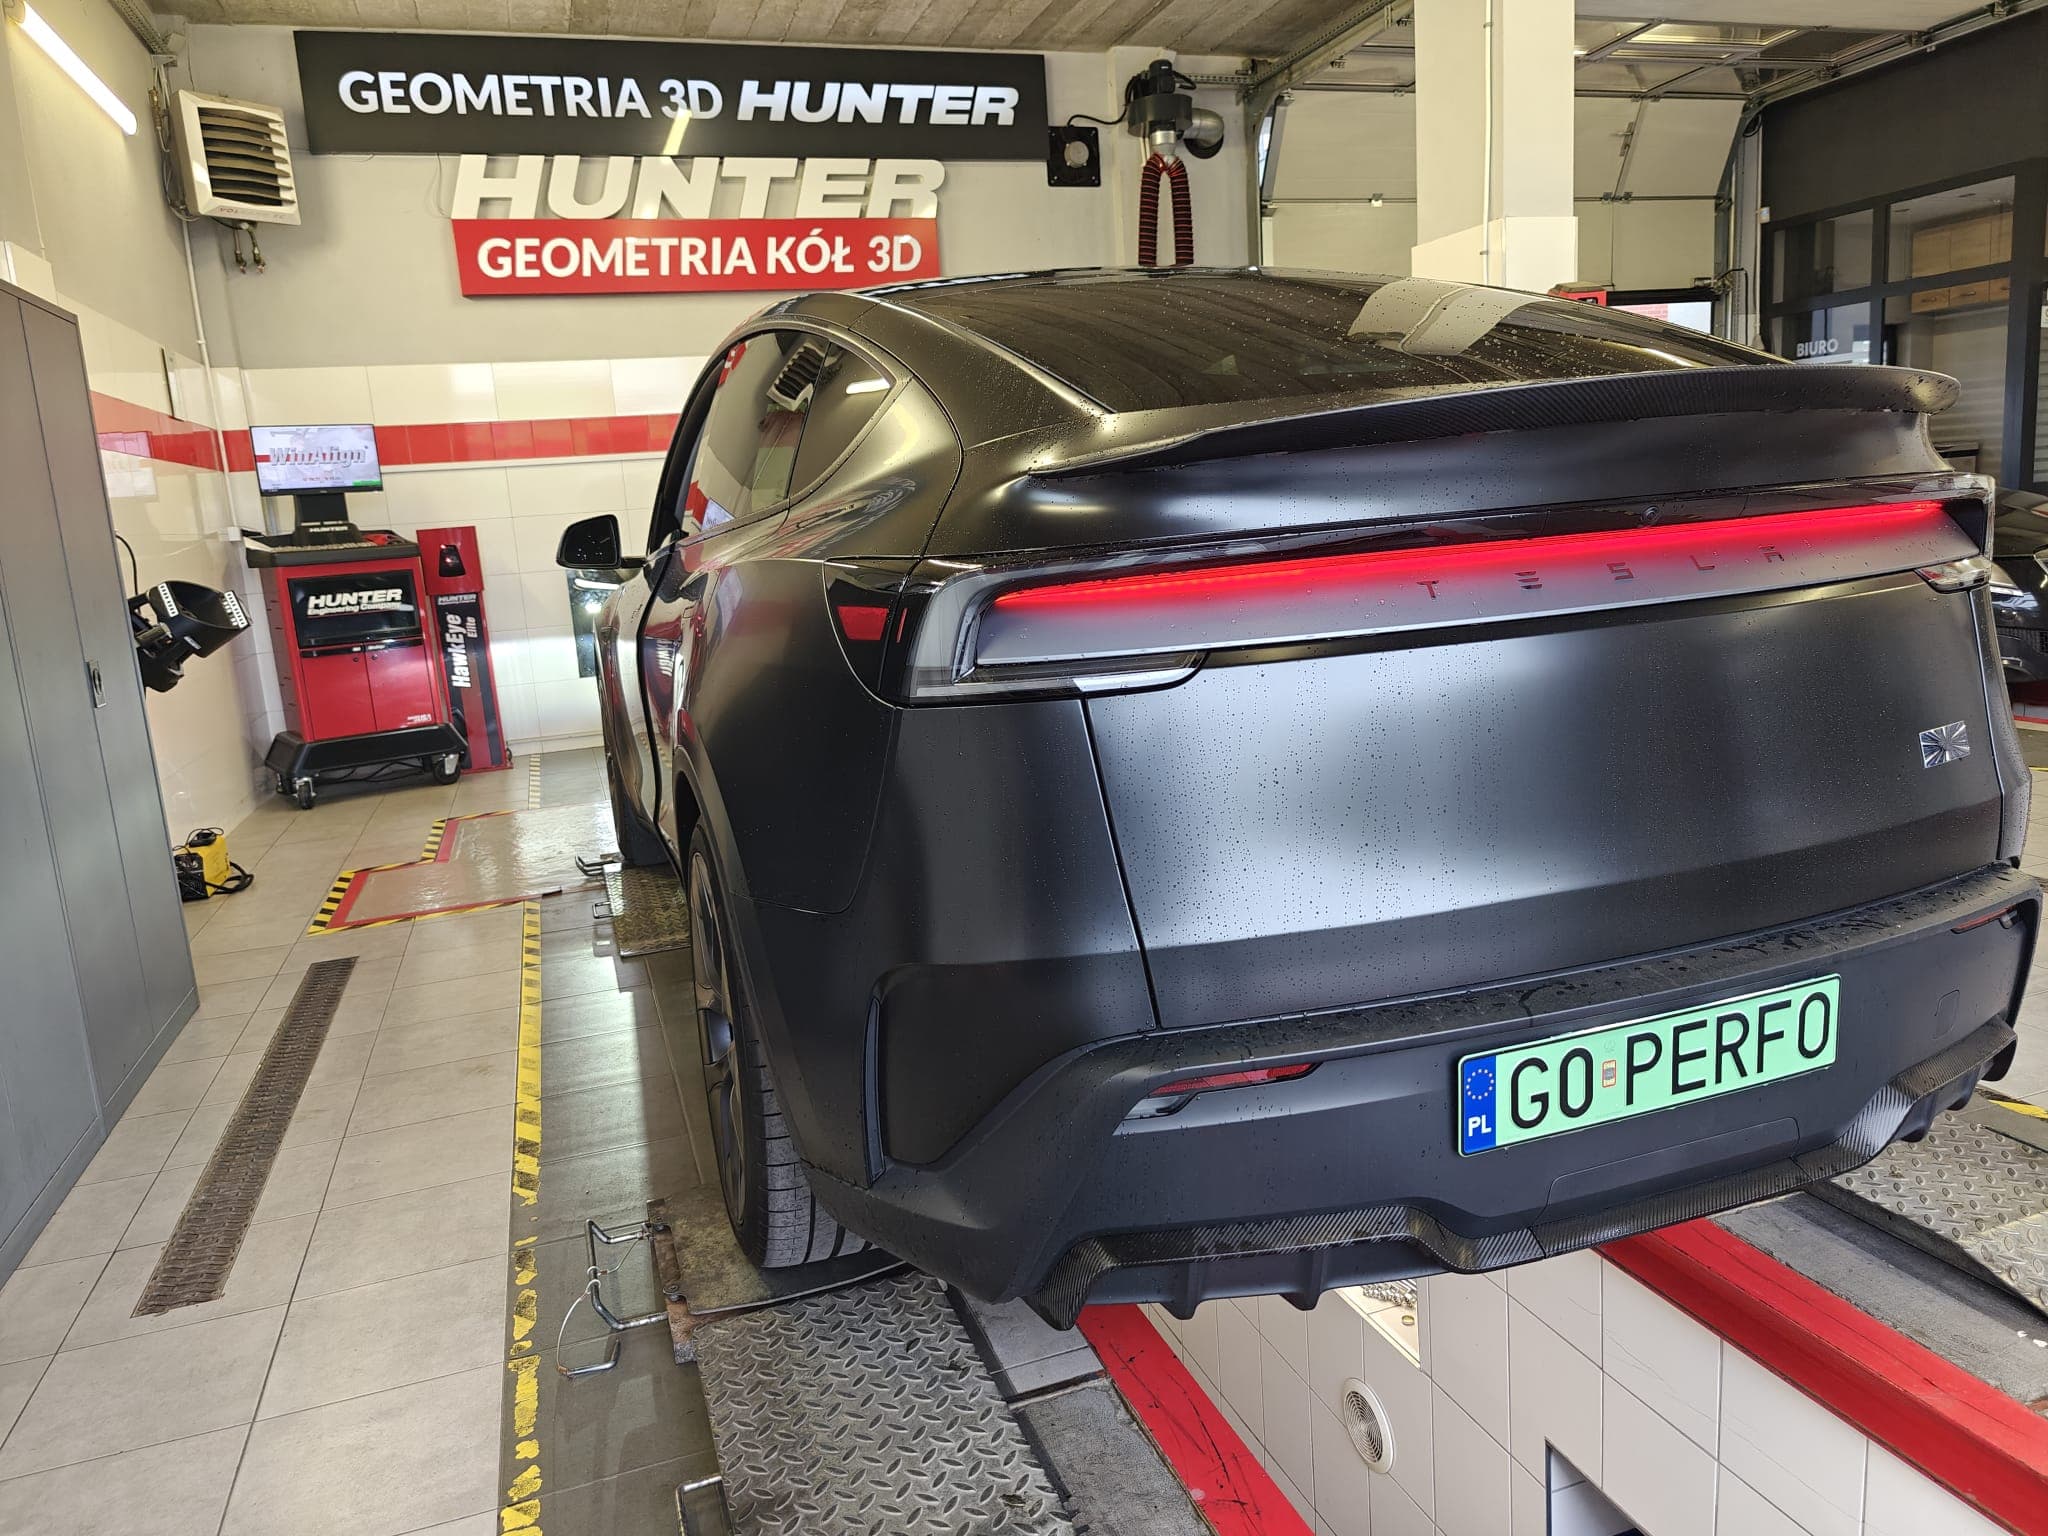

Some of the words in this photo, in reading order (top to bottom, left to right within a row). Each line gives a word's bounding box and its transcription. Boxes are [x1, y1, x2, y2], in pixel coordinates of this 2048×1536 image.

[338, 70, 652, 119] GEOMETRIA
[659, 79, 723, 120] 3D
[737, 80, 1019, 126] HUNTER
[451, 154, 945, 219] HUNTER
[477, 235, 757, 278] GEOMETRIA
[767, 228, 854, 274] KÓŁ
[867, 234, 922, 273] 3D
[1796, 338, 1839, 358] BIURO
[1416, 545, 1785, 600] TESLA
[307, 588, 403, 609] HUNTER
[445, 613, 472, 688] HawkEye
[465, 616, 478, 638] Elite
[1467, 1115, 1492, 1137] PL
